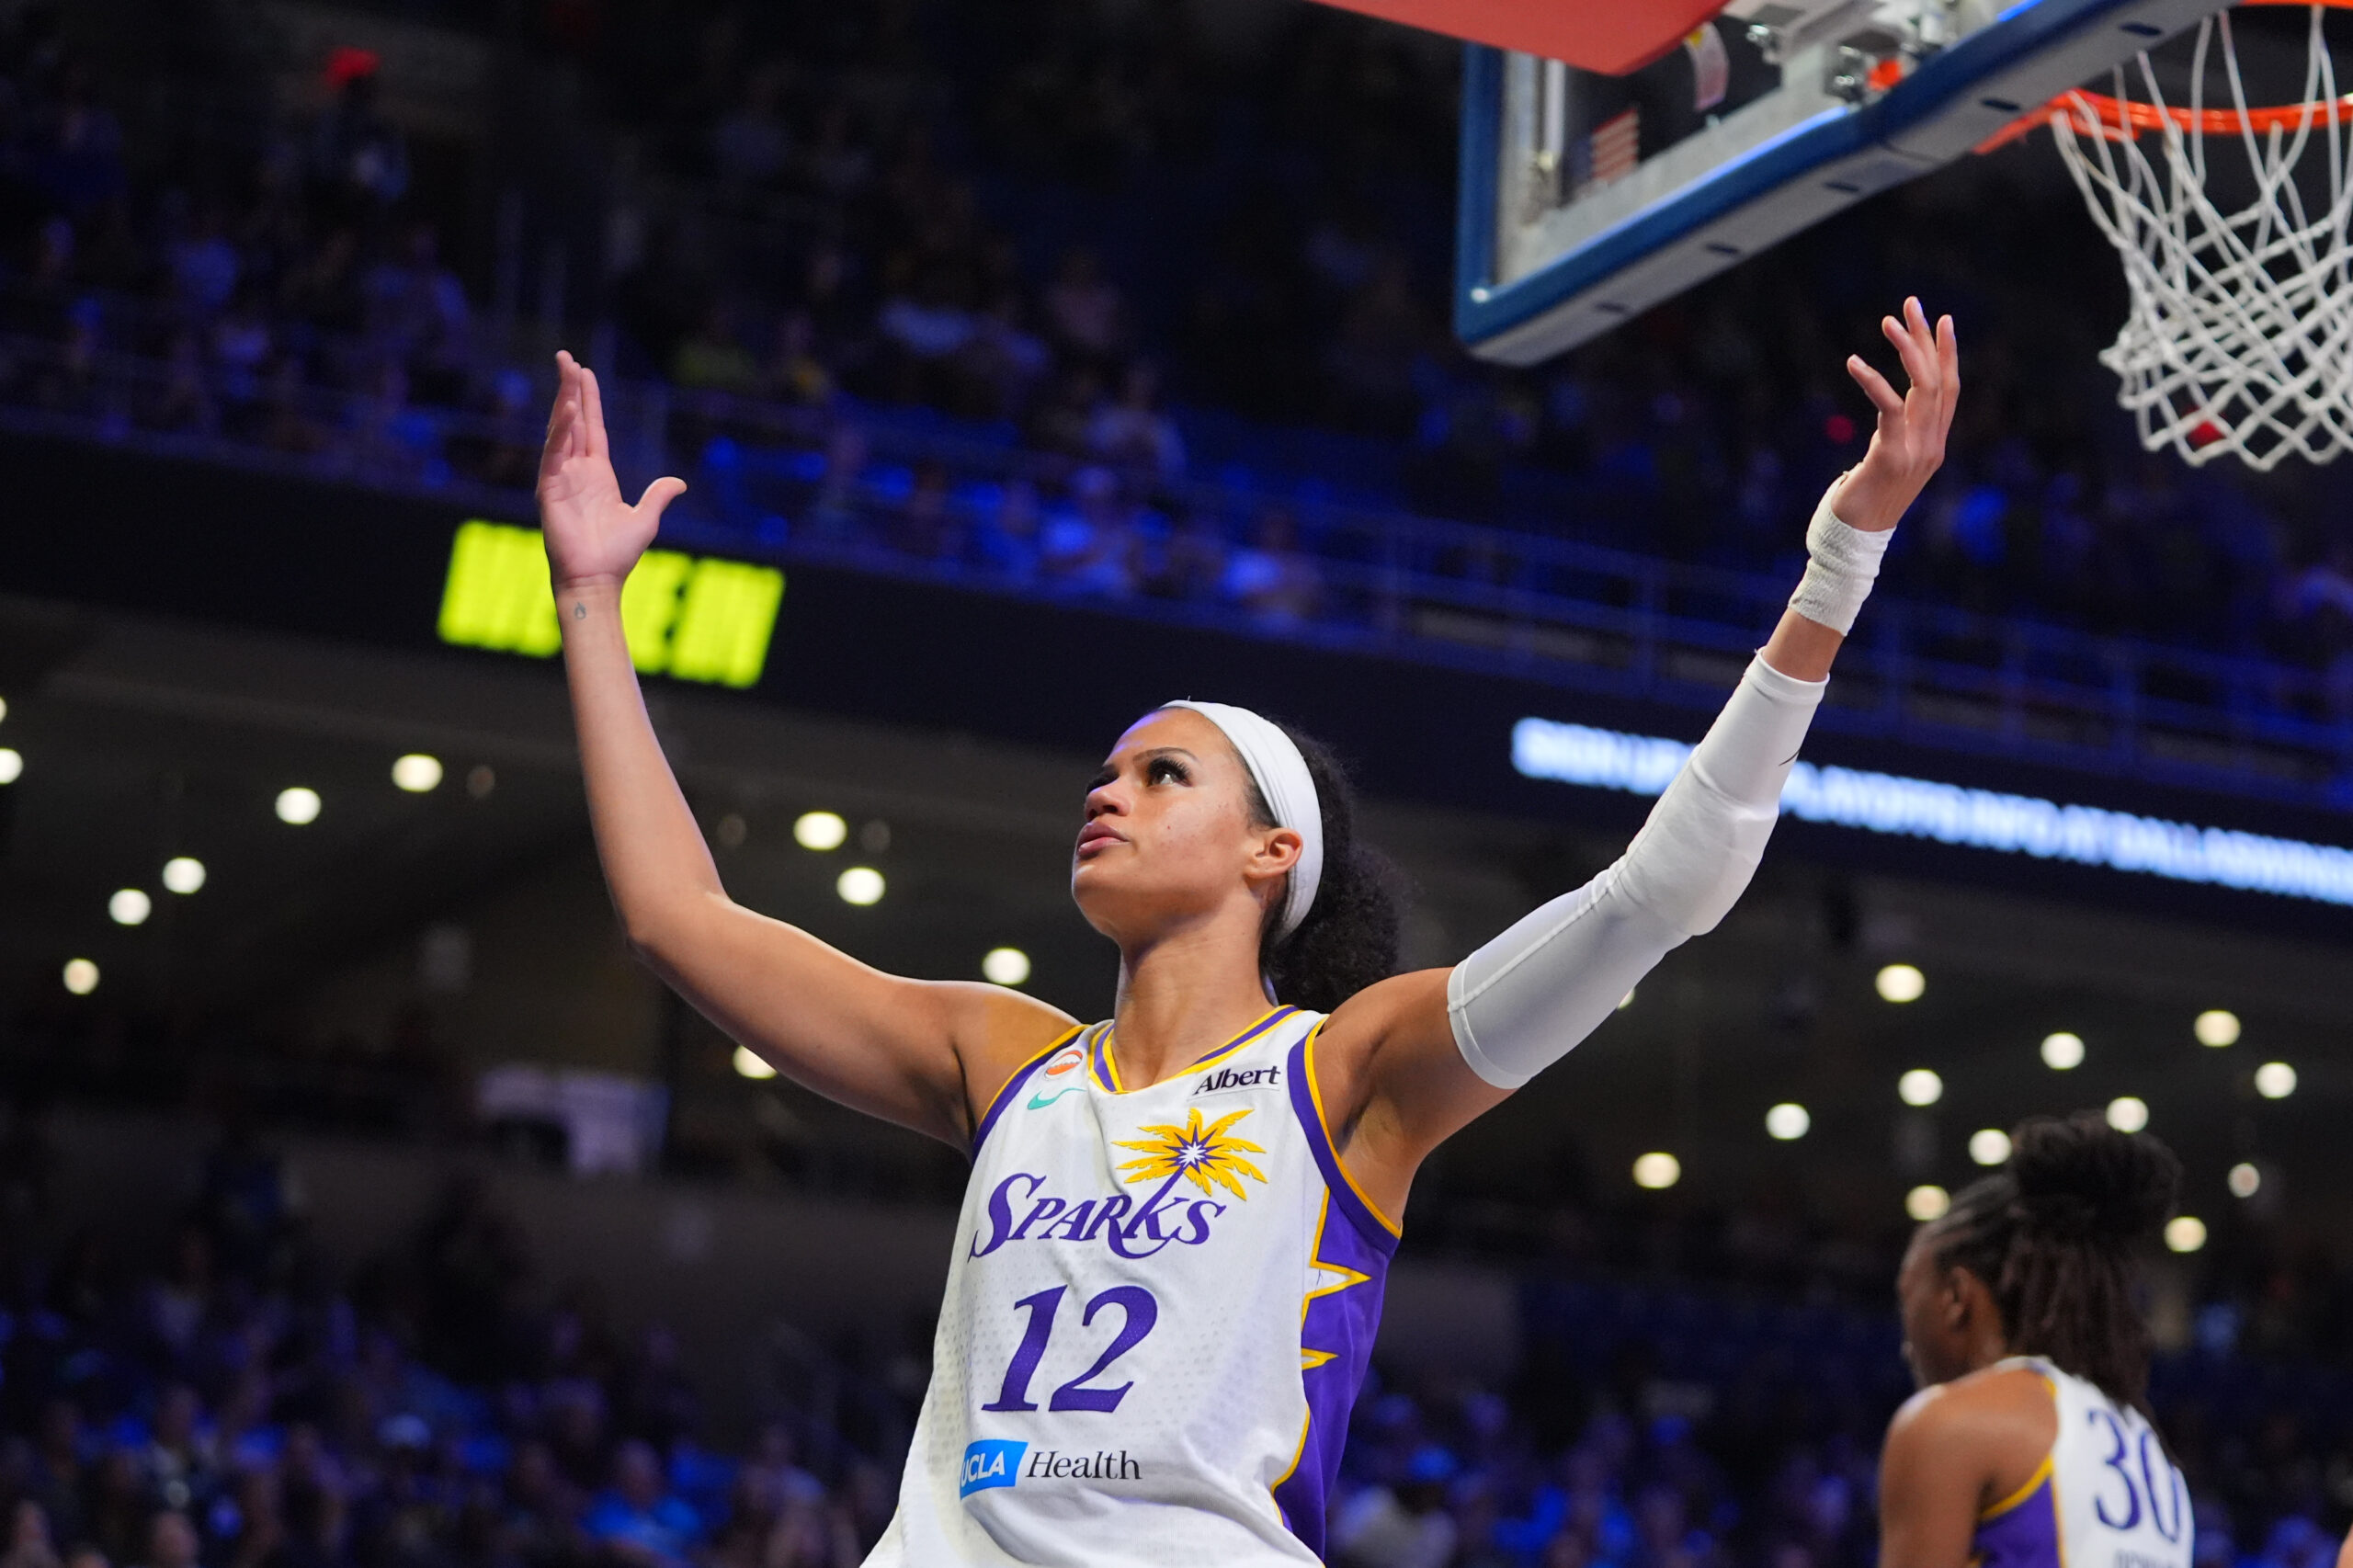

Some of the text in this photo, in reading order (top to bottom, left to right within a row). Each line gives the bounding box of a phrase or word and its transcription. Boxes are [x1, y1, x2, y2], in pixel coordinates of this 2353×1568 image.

[1192, 1065, 1281, 1096] Albert
[981, 1284, 1159, 1414] 12
[961, 1450, 1143, 1488] UCLA Health
[2087, 1408, 2182, 1543] 30
